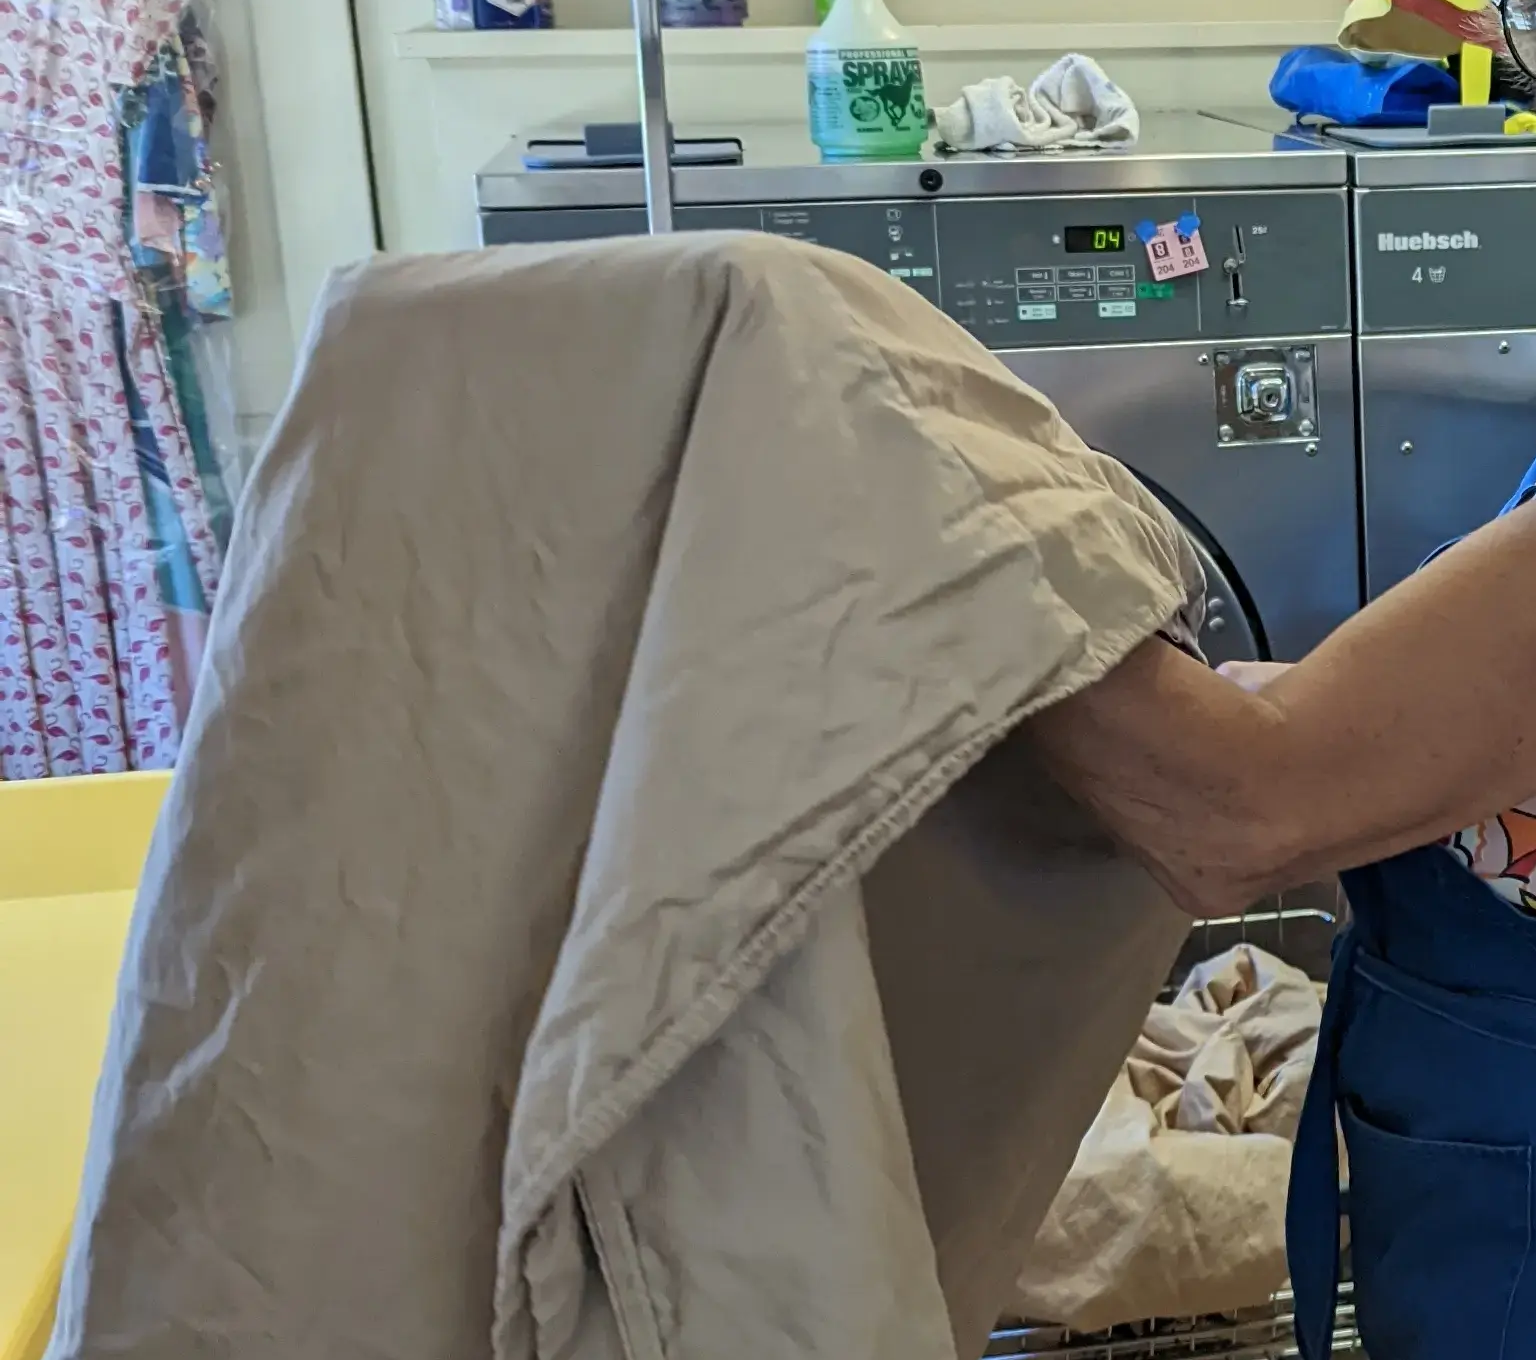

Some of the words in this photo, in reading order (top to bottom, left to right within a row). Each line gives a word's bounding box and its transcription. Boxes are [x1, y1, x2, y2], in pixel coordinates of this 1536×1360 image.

[1094, 229, 1121, 251] 04
[1378, 230, 1479, 252] Huebsch
[1154, 242, 1165, 258] 8
[1156, 264, 1176, 276] 204
[1182, 257, 1201, 269] 204
[1411, 266, 1423, 283] 4
